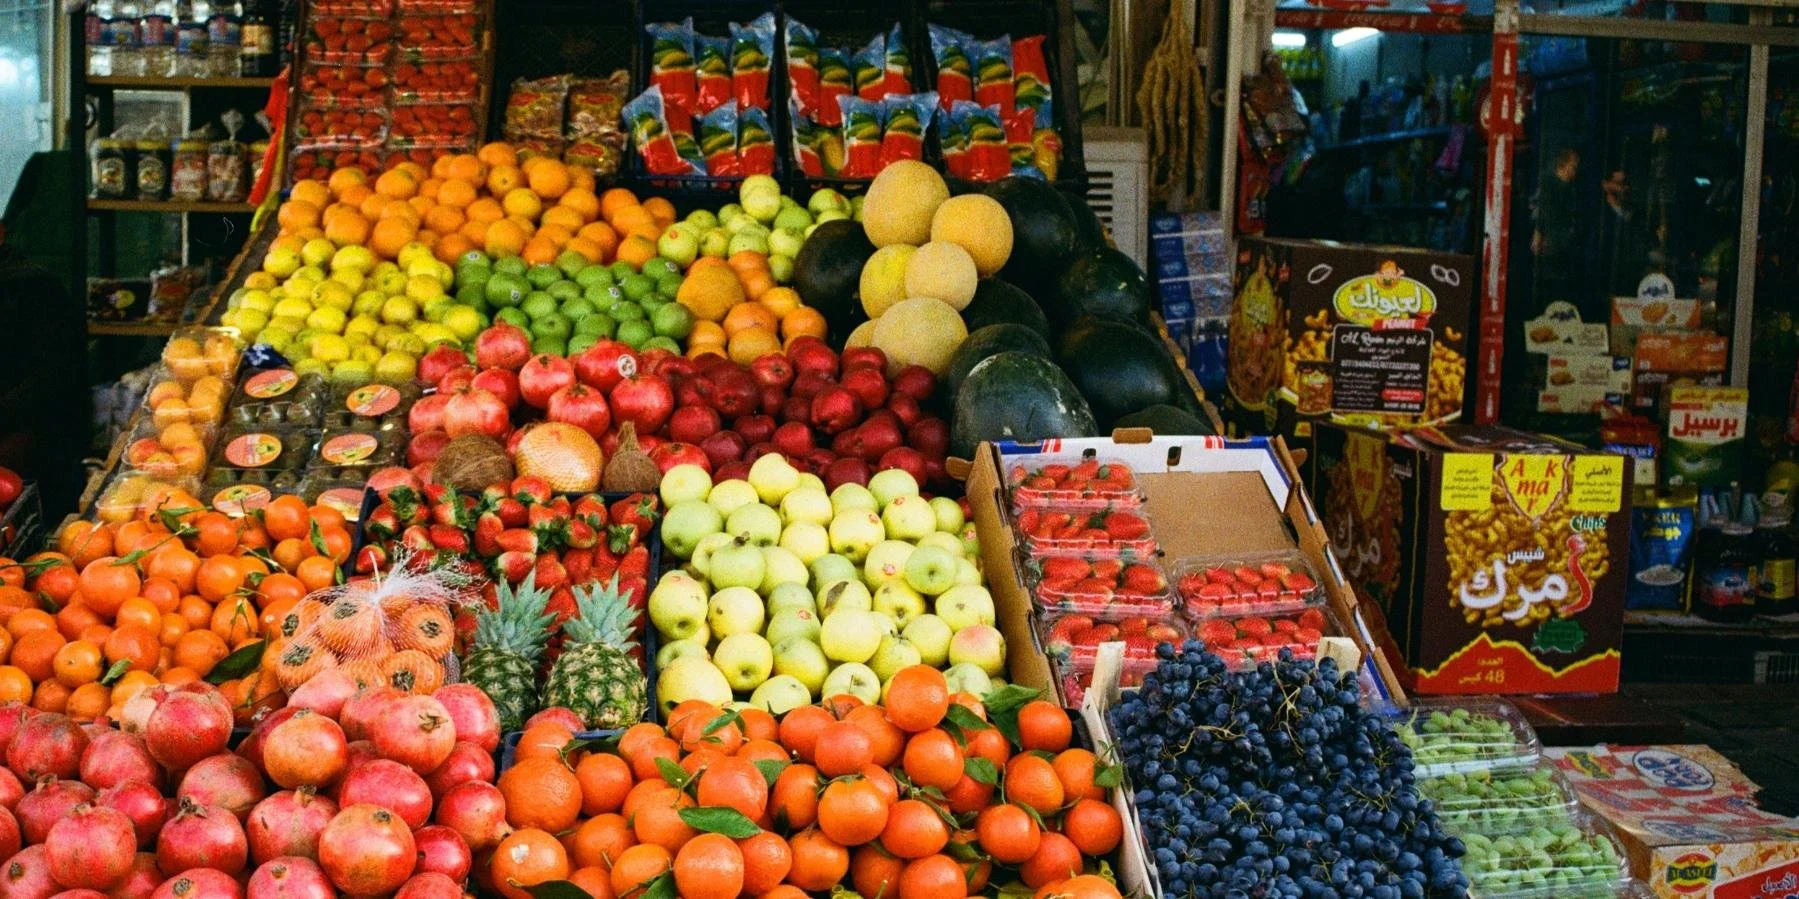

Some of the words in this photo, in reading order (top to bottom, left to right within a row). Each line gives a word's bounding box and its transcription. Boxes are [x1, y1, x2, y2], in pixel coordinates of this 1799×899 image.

[1672, 412, 1738, 437] برسيل
[1507, 546, 1544, 564] شيبس
[1484, 670, 1504, 684] 48
